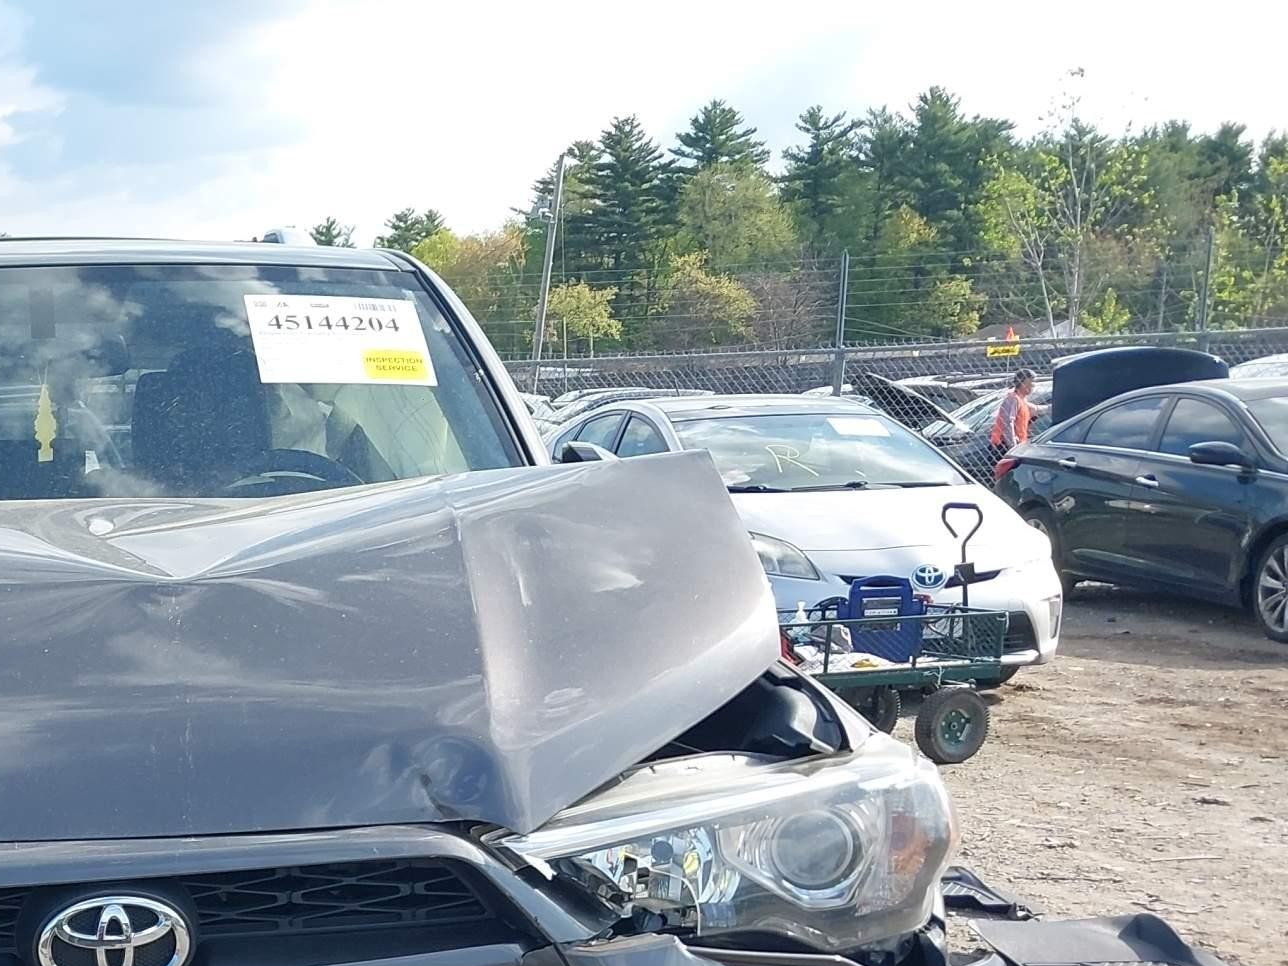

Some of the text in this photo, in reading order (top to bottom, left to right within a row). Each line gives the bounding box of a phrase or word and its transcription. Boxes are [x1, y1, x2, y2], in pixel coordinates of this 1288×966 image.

[267, 314, 400, 332] 45144204
[365, 356, 423, 364] INSPECTION
[375, 364, 419, 372] SERVICE
